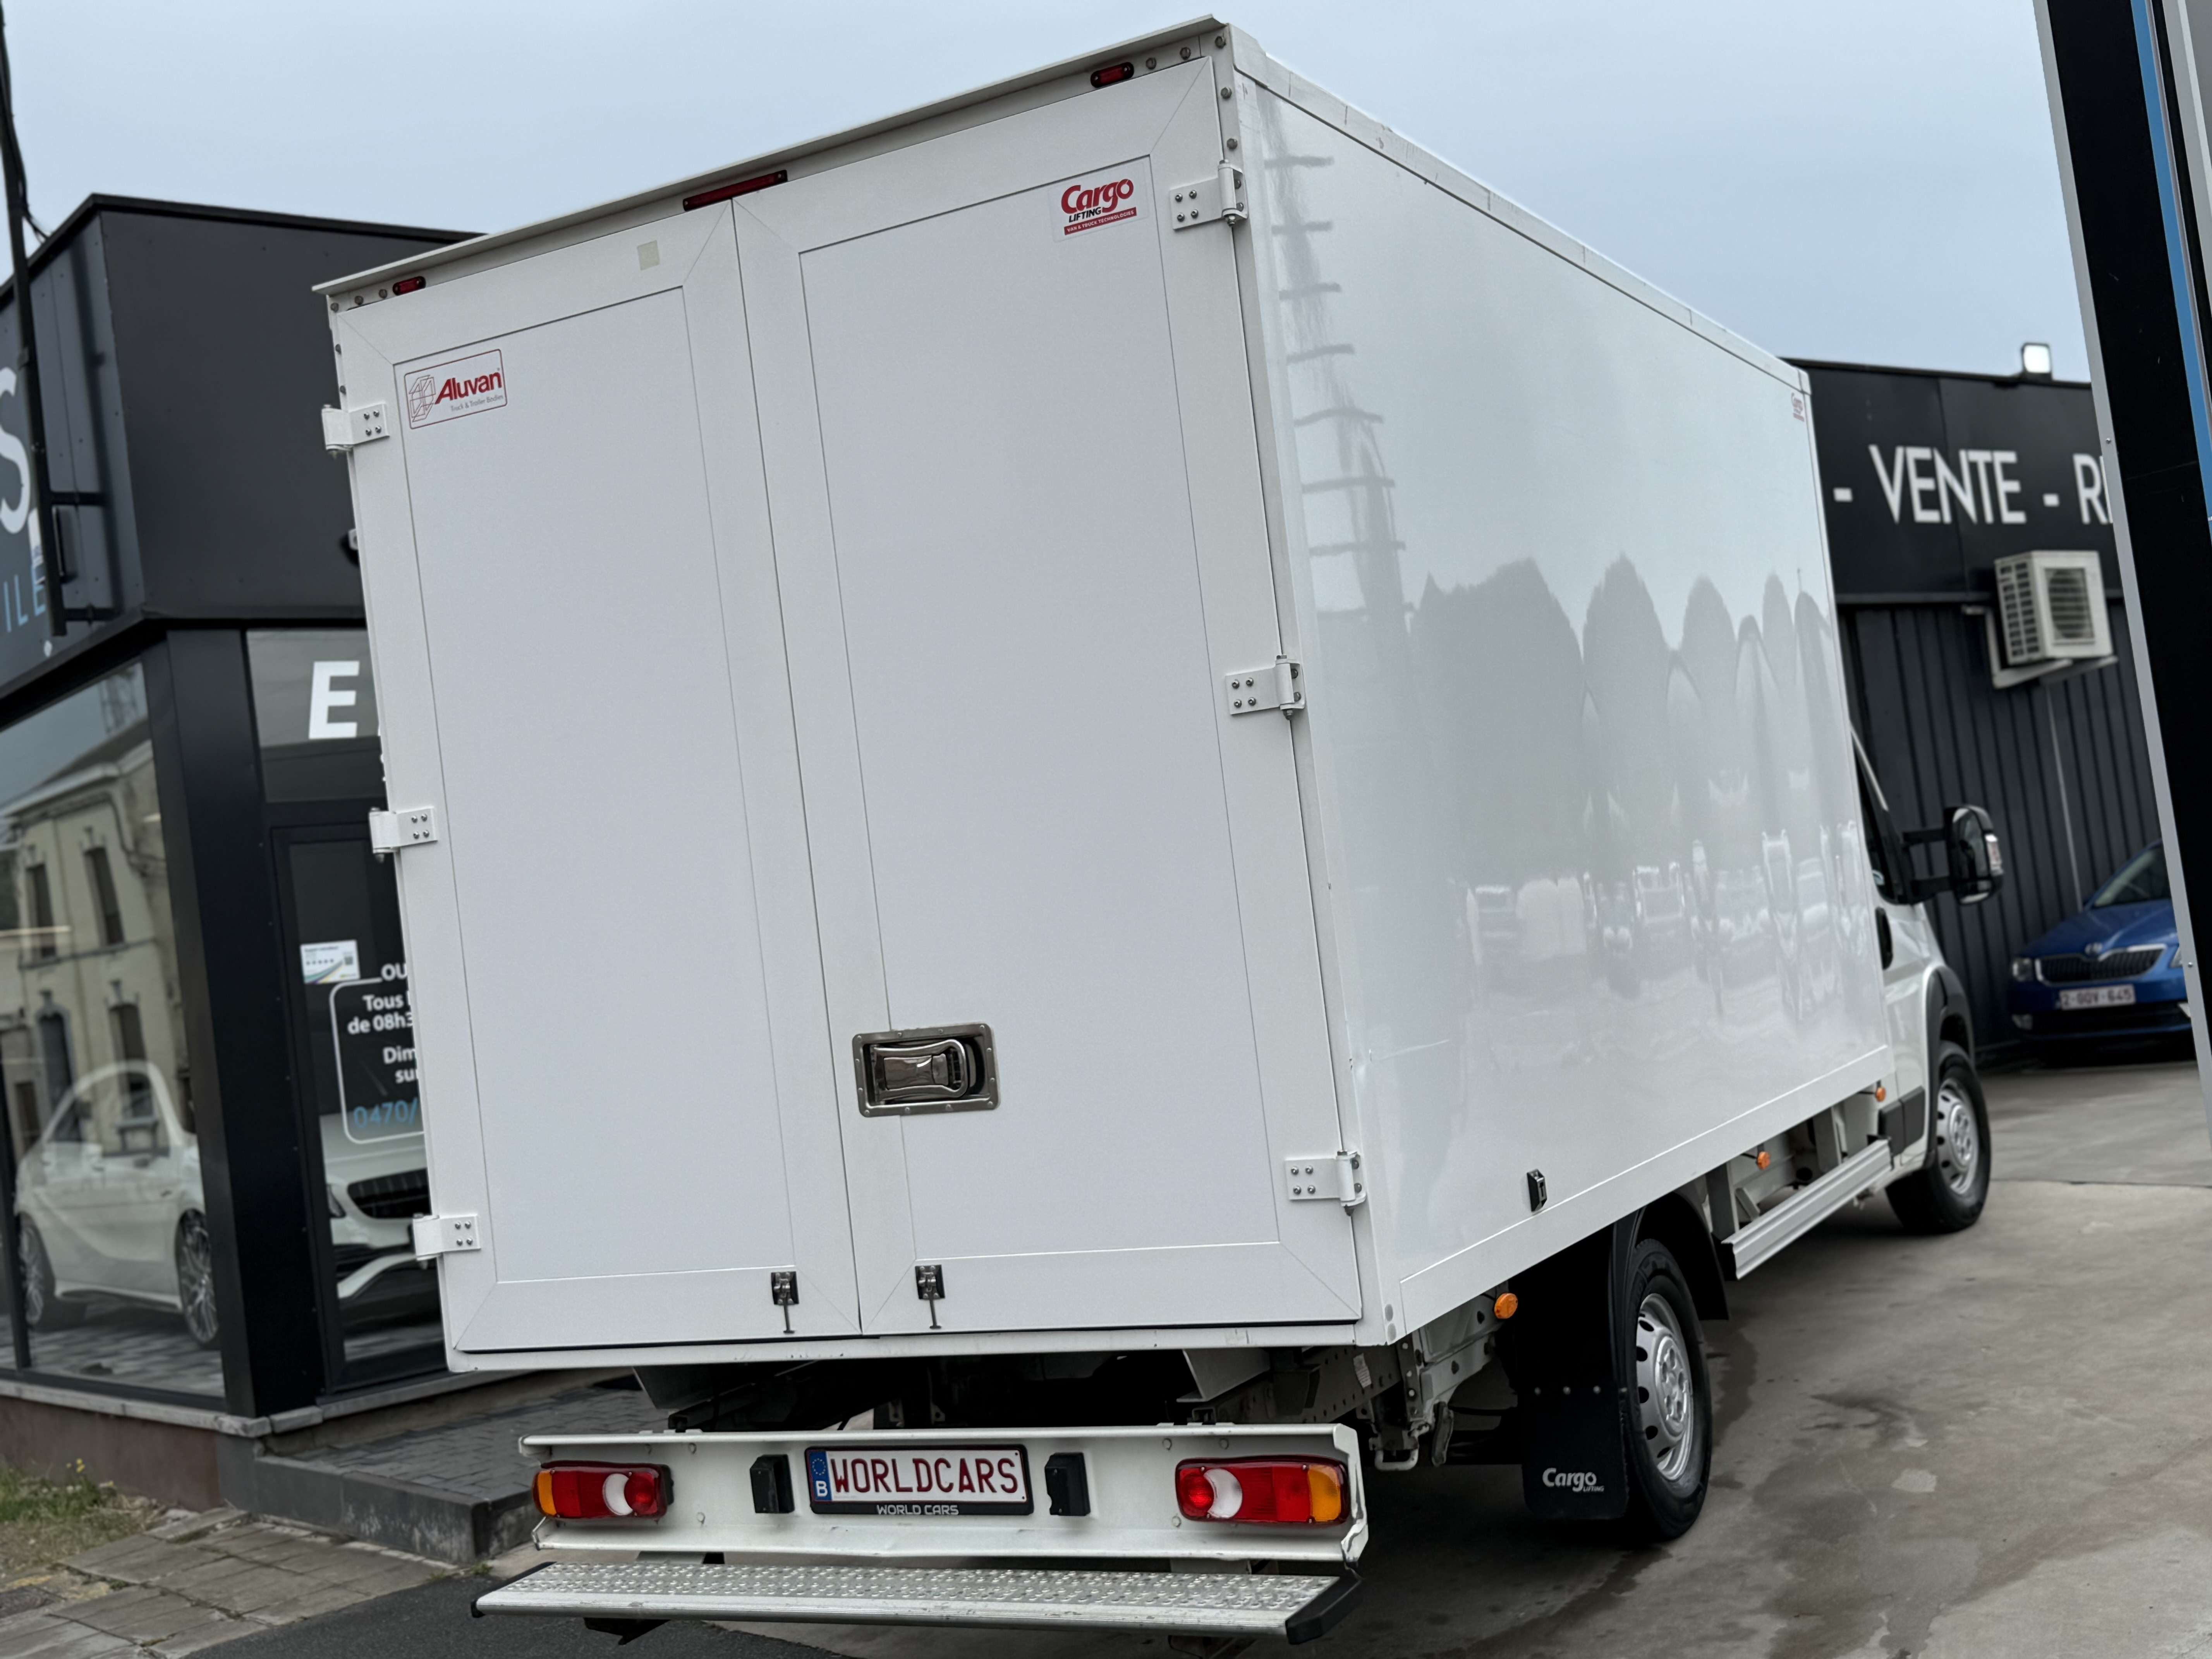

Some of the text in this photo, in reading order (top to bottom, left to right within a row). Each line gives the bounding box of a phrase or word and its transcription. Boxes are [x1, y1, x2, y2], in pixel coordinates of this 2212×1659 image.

[1061, 179, 1134, 214] Cargo
[1069, 207, 1101, 223] LIFTING
[434, 372, 502, 404] Aluvan
[1868, 445, 2027, 524] VENTE
[2073, 453, 2114, 525] R
[362, 993, 404, 1011] Tous
[348, 1016, 370, 1034] de
[816, 1458, 1018, 1497] B WORLDCARS
[1542, 1467, 1597, 1492] Cargo
[877, 1504, 959, 1515] WORLD CARS
